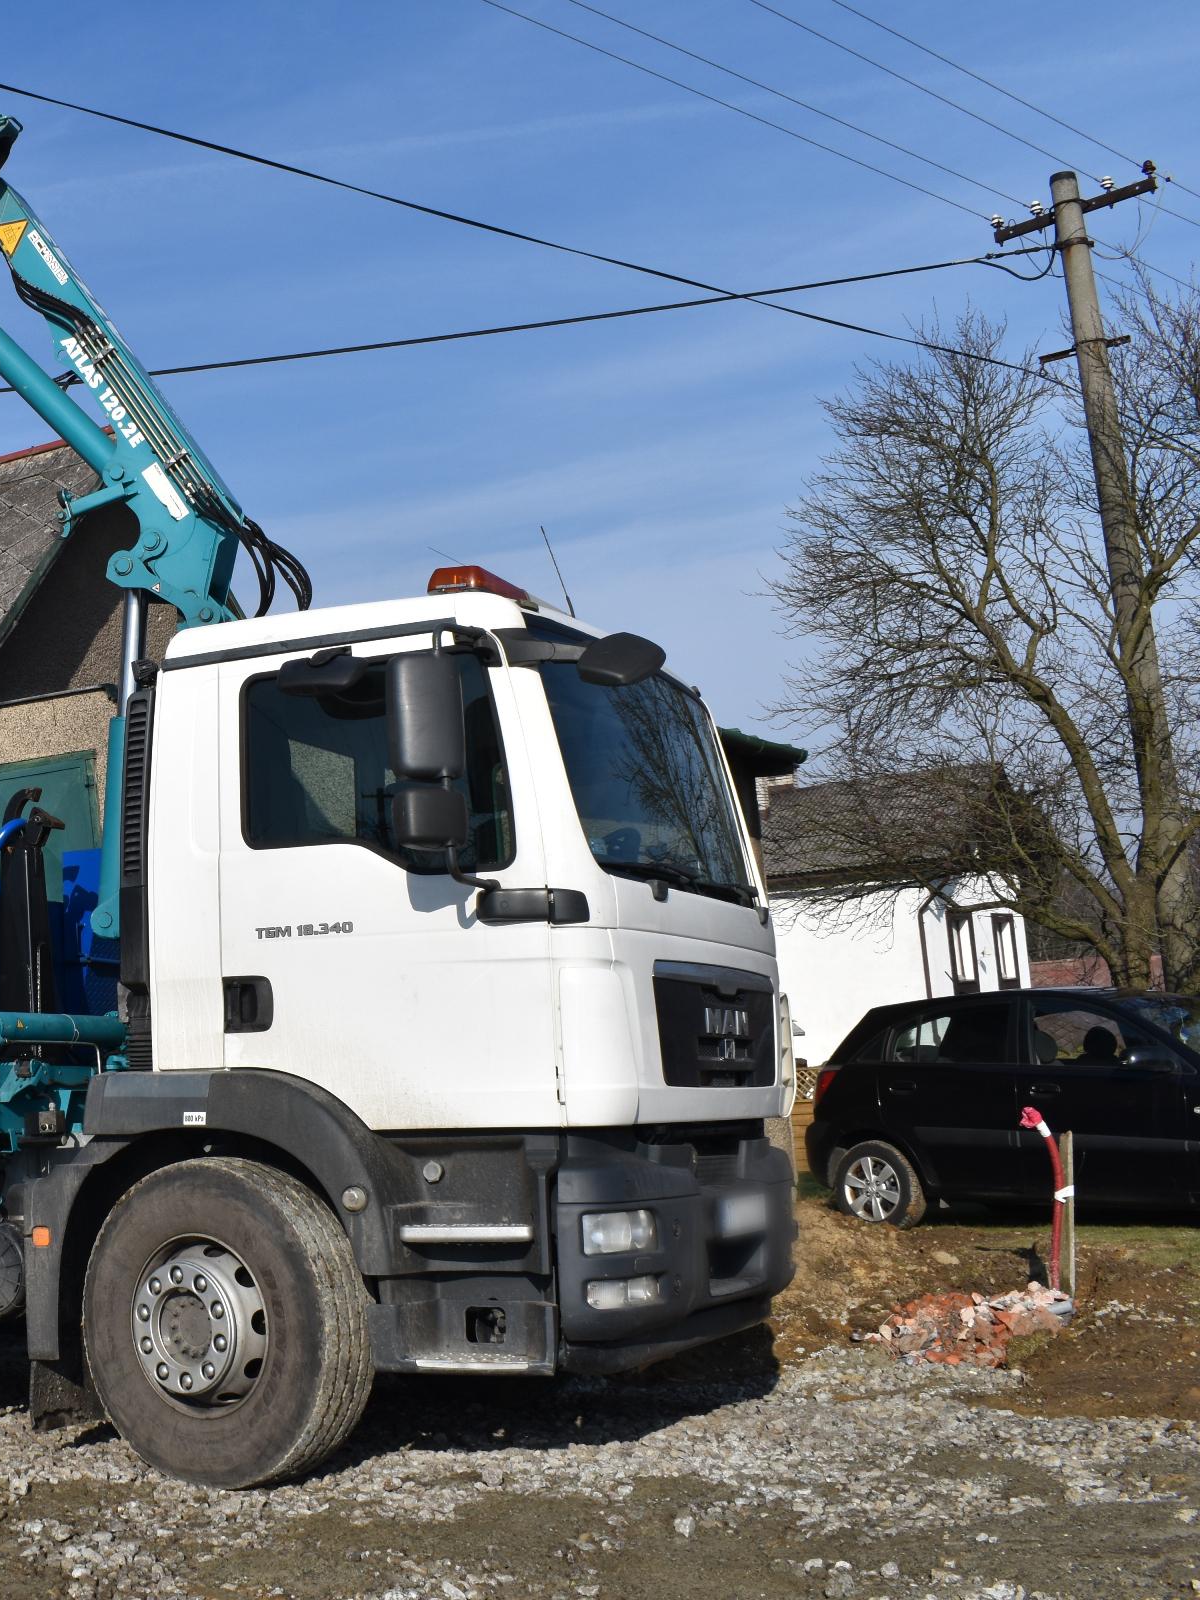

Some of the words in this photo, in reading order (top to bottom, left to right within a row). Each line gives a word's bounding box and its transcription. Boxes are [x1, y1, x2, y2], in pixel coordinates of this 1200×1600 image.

[59, 336, 105, 390] ATLAS
[97, 386, 146, 449] 120.2E
[255, 925, 292, 940] TGM
[296, 921, 354, 937] 18.340
[705, 1008, 749, 1036] MAN
